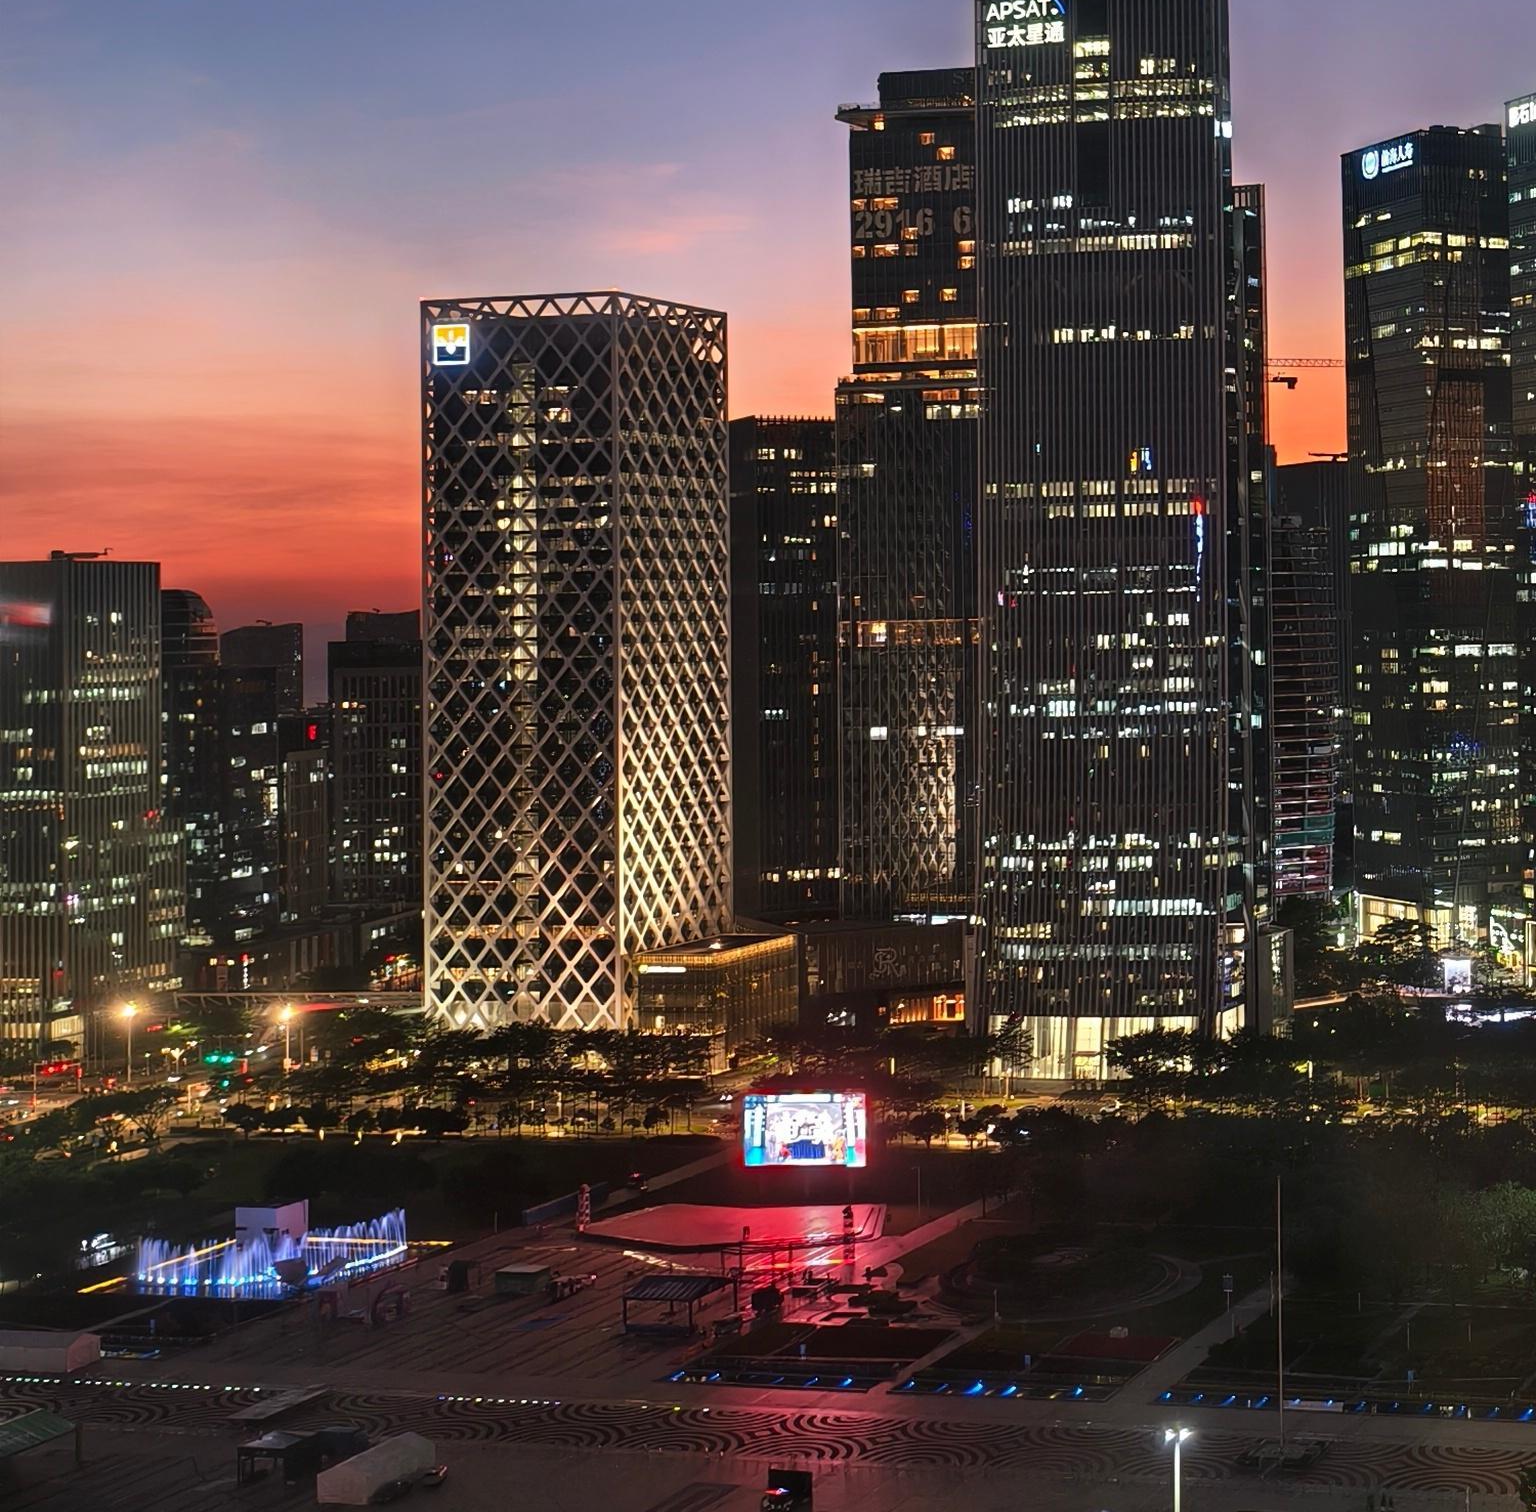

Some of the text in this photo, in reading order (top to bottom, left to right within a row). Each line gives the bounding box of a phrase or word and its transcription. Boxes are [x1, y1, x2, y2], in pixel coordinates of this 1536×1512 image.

[987, 21, 1065, 48] 亚太星通
[853, 164, 975, 195] 瑞吉酒店
[854, 207, 935, 239] 2916
